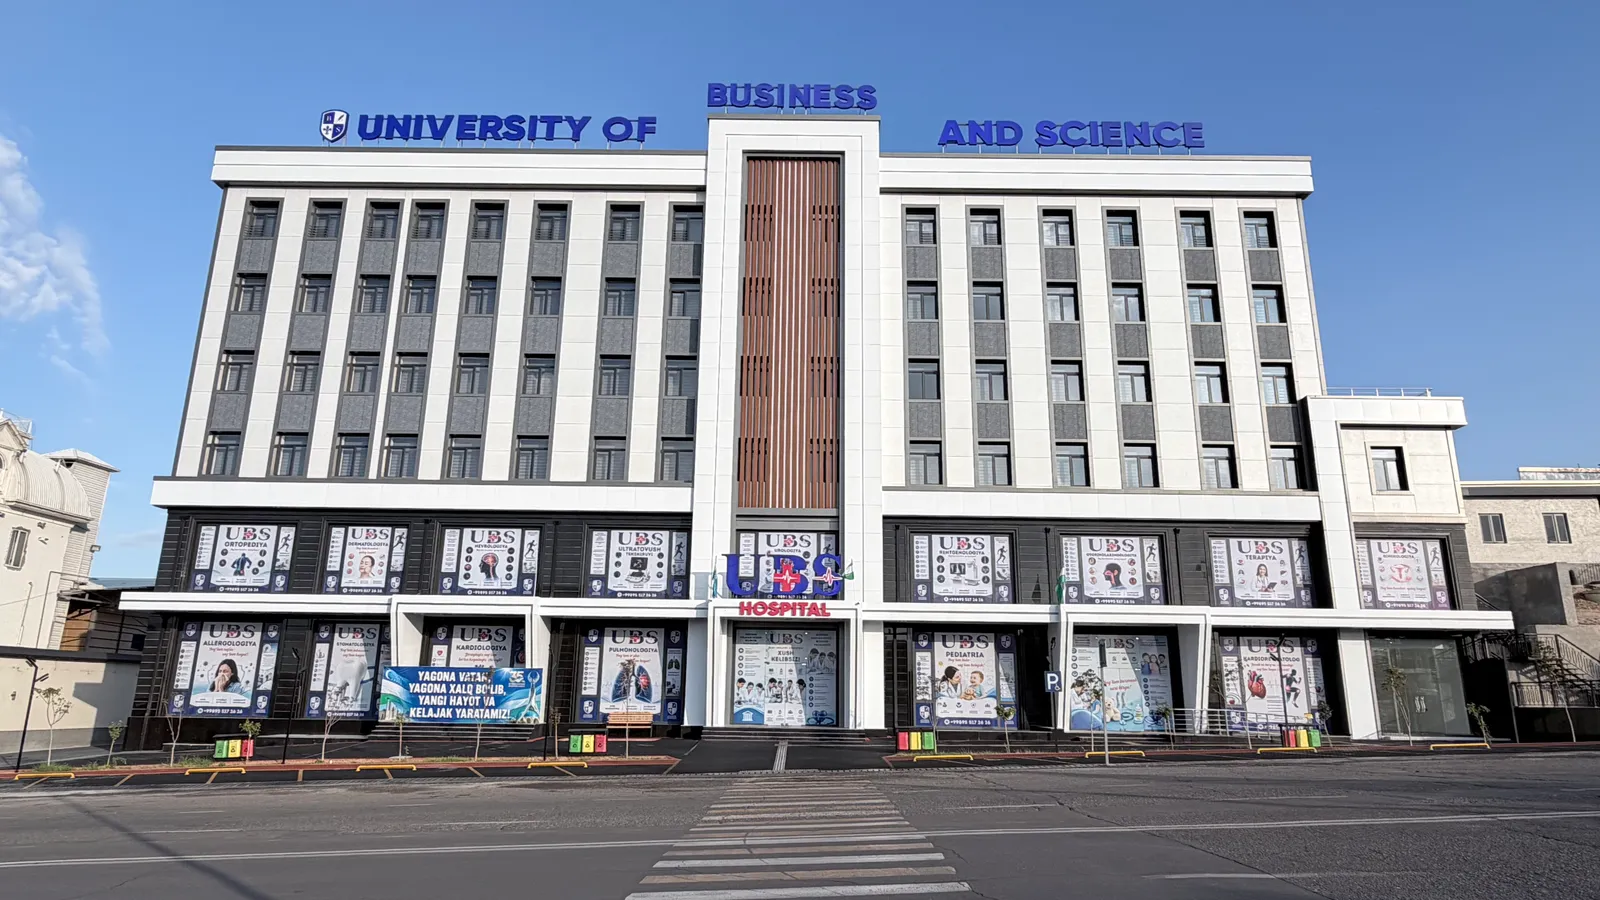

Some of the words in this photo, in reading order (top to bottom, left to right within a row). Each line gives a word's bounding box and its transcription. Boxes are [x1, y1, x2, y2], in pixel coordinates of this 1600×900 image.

[706, 82, 878, 110] BUSINESS
[357, 114, 592, 142] UNIVERSITY
[602, 116, 658, 142] OF
[938, 120, 1024, 146] AND
[1034, 120, 1205, 148] SCIENCE
[226, 527, 271, 540] UBS
[352, 528, 389, 540] UBS
[471, 530, 515, 543] UBS
[618, 532, 663, 546] UBS
[766, 534, 811, 548] UBS
[940, 537, 985, 550] UBS
[1088, 539, 1134, 552] UBS
[1237, 540, 1283, 554] UBS
[1377, 542, 1418, 554] UBS
[722, 553, 842, 596] UBS
[739, 601, 830, 616] HOSPITAL
[209, 624, 256, 638] UBS
[338, 627, 377, 639] UBS
[460, 628, 507, 642] UBS
[611, 630, 658, 644] UBS
[770, 632, 803, 644] UBS
[941, 635, 989, 648] UBS
[418, 671, 455, 682] YAGONA
[1047, 674, 1058, 689] P
[409, 683, 448, 694] YAGONA
[449, 684, 473, 695] XALQ
[418, 695, 447, 706] YANGI
[449, 696, 480, 706] HAYOT
[483, 696, 495, 706] VA
[409, 708, 452, 718] KELAJAK
[455, 708, 511, 719] YARATAMIZ!
